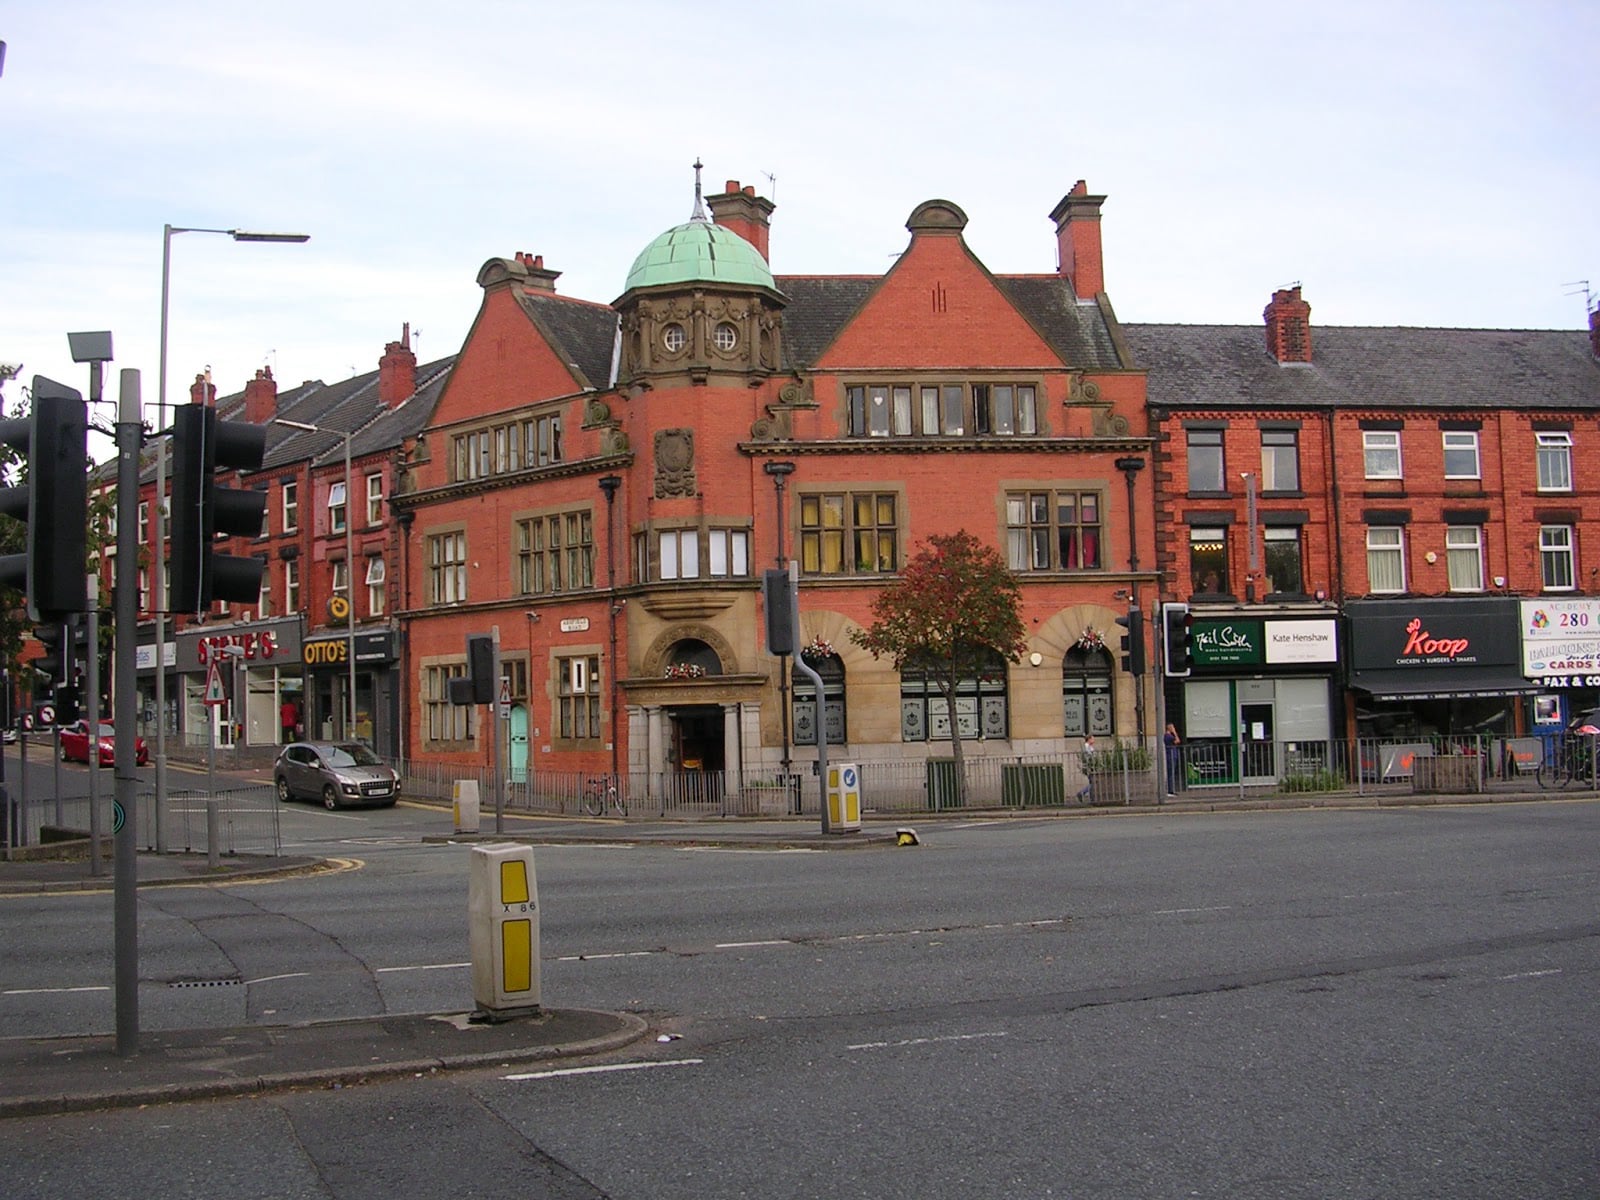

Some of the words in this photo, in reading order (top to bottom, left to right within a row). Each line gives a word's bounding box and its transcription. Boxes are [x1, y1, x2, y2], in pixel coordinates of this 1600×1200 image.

[1560, 613, 1588, 626] 280
[1273, 634, 1291, 643] Kate
[1293, 633, 1328, 642] Henshaw
[1402, 630, 1469, 657] Koop
[1549, 660, 1592, 669] CARDS
[1544, 676, 1568, 687] FAX
[1571, 676, 1582, 687] &
[504, 905, 511, 913] X
